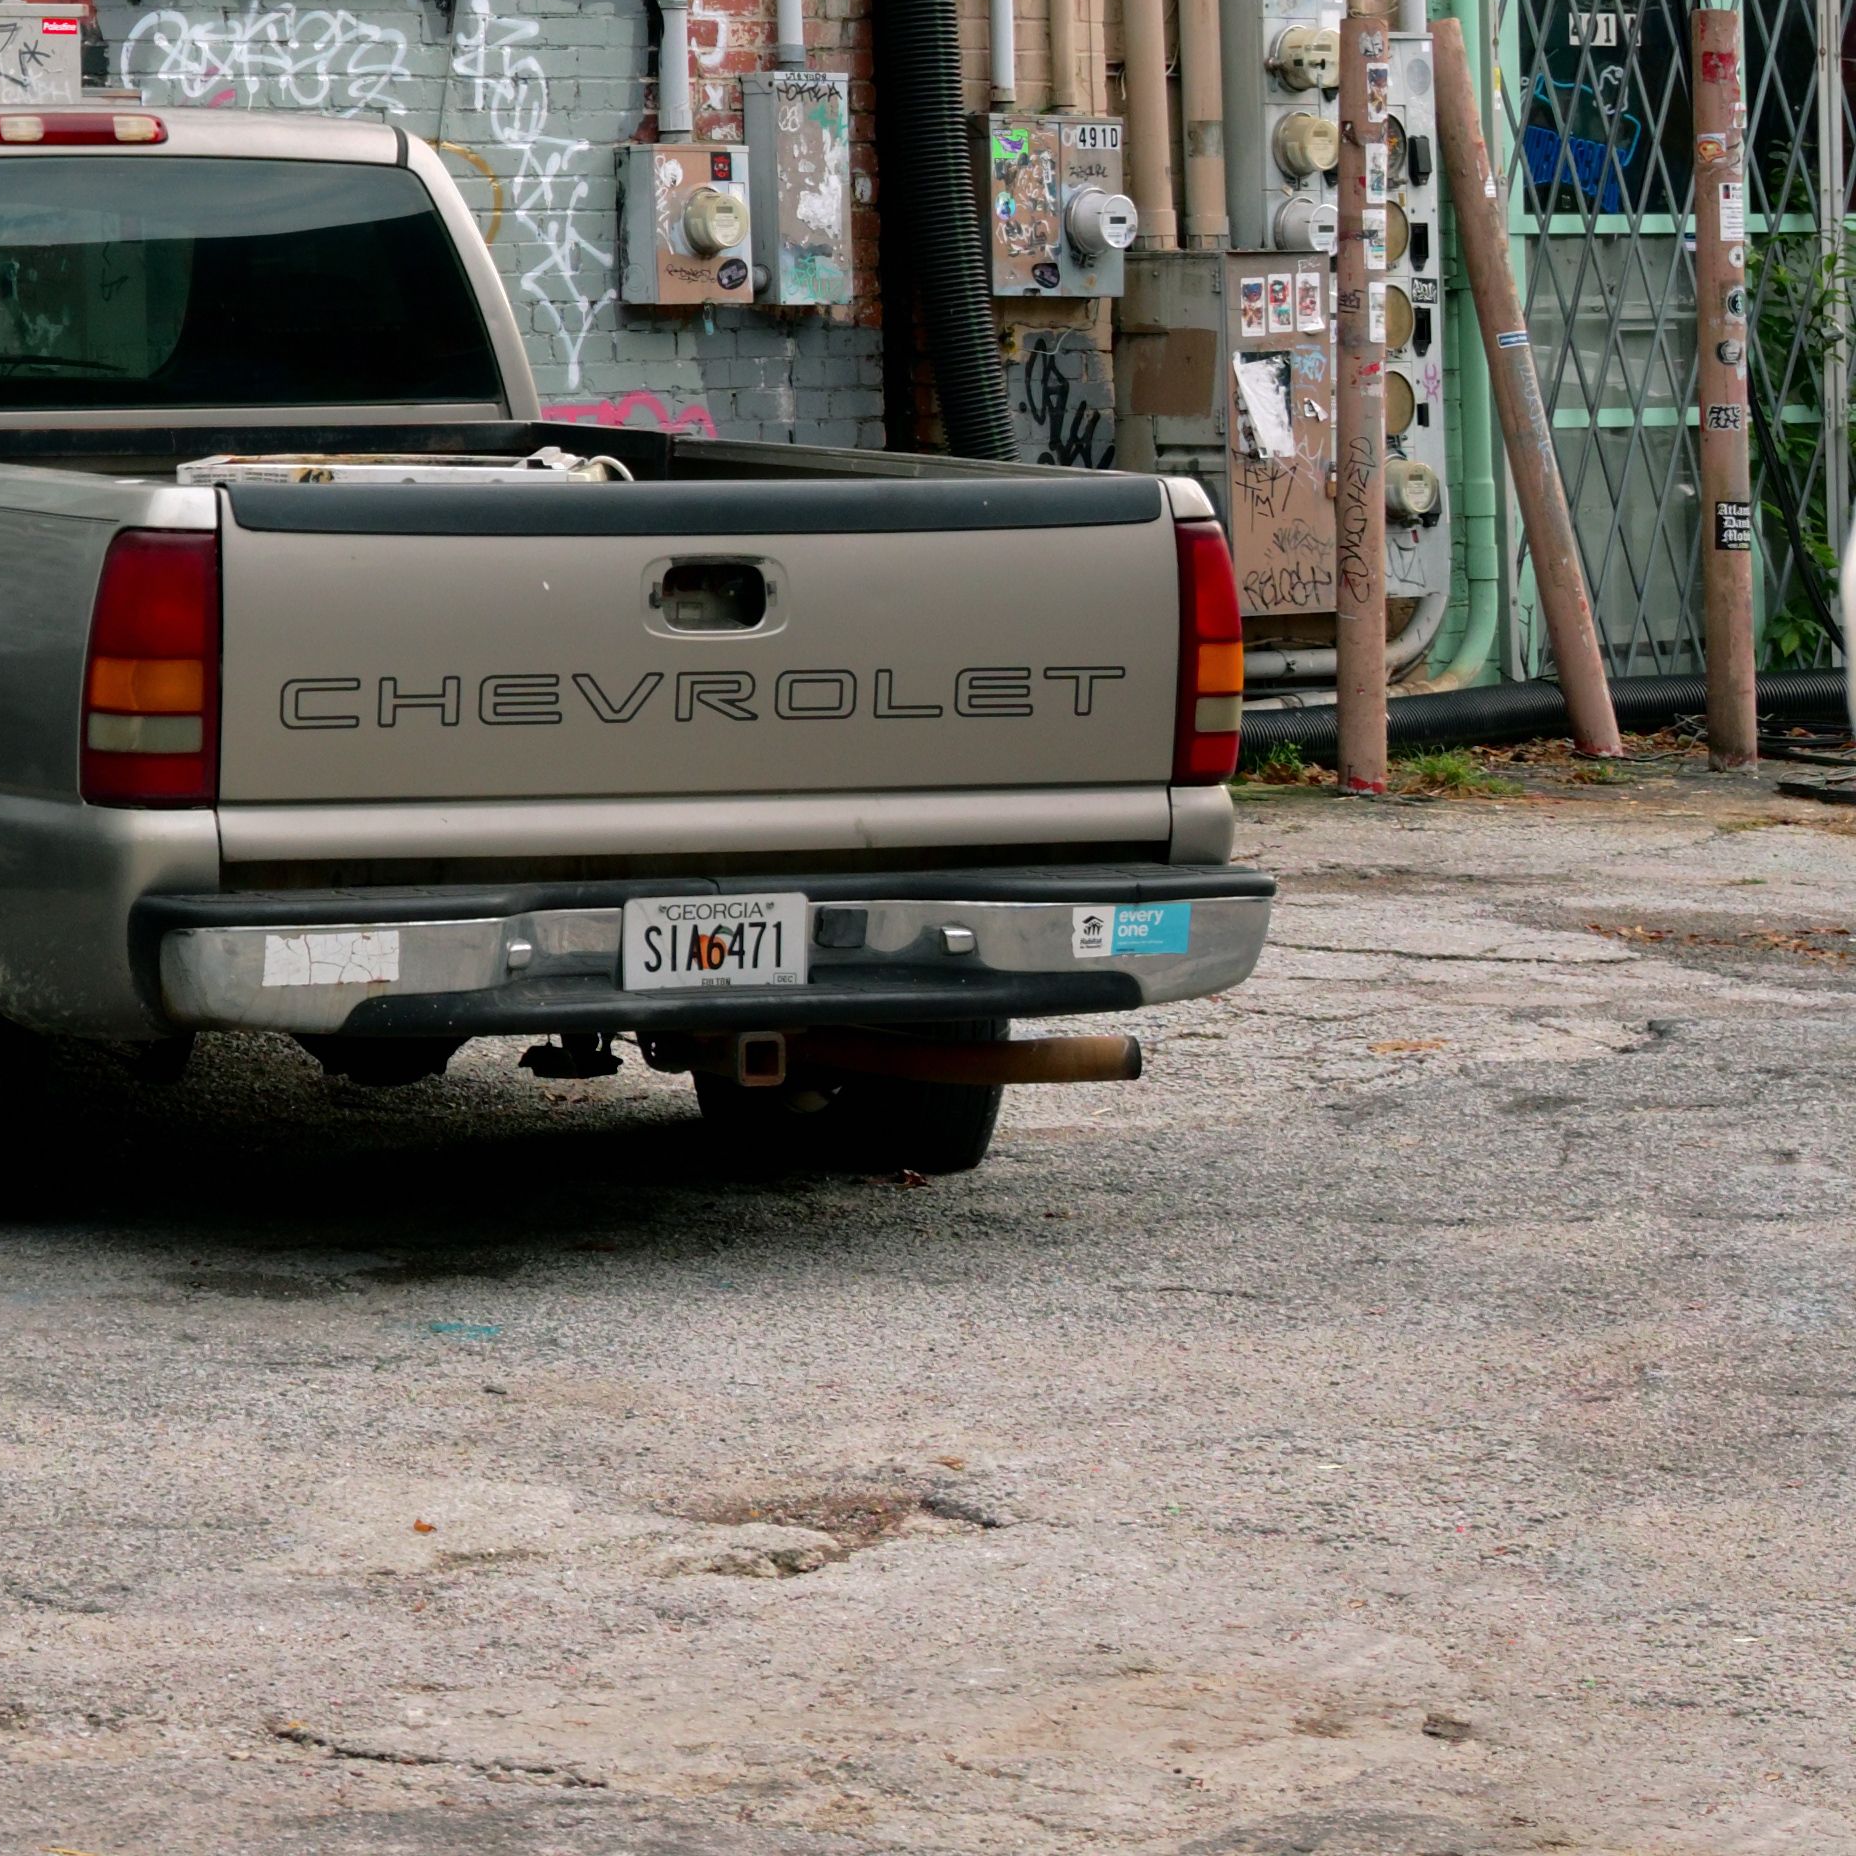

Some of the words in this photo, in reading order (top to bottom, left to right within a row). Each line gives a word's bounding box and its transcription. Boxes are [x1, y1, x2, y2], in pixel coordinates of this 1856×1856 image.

[1079, 126, 1119, 148] 491D
[280, 664, 1126, 729] CHEVROLET
[666, 901, 764, 921] GEORGIA
[1119, 909, 1164, 926] every
[1117, 924, 1149, 937] one
[644, 921, 783, 973] SIA6471
[777, 975, 793, 984] DEC
